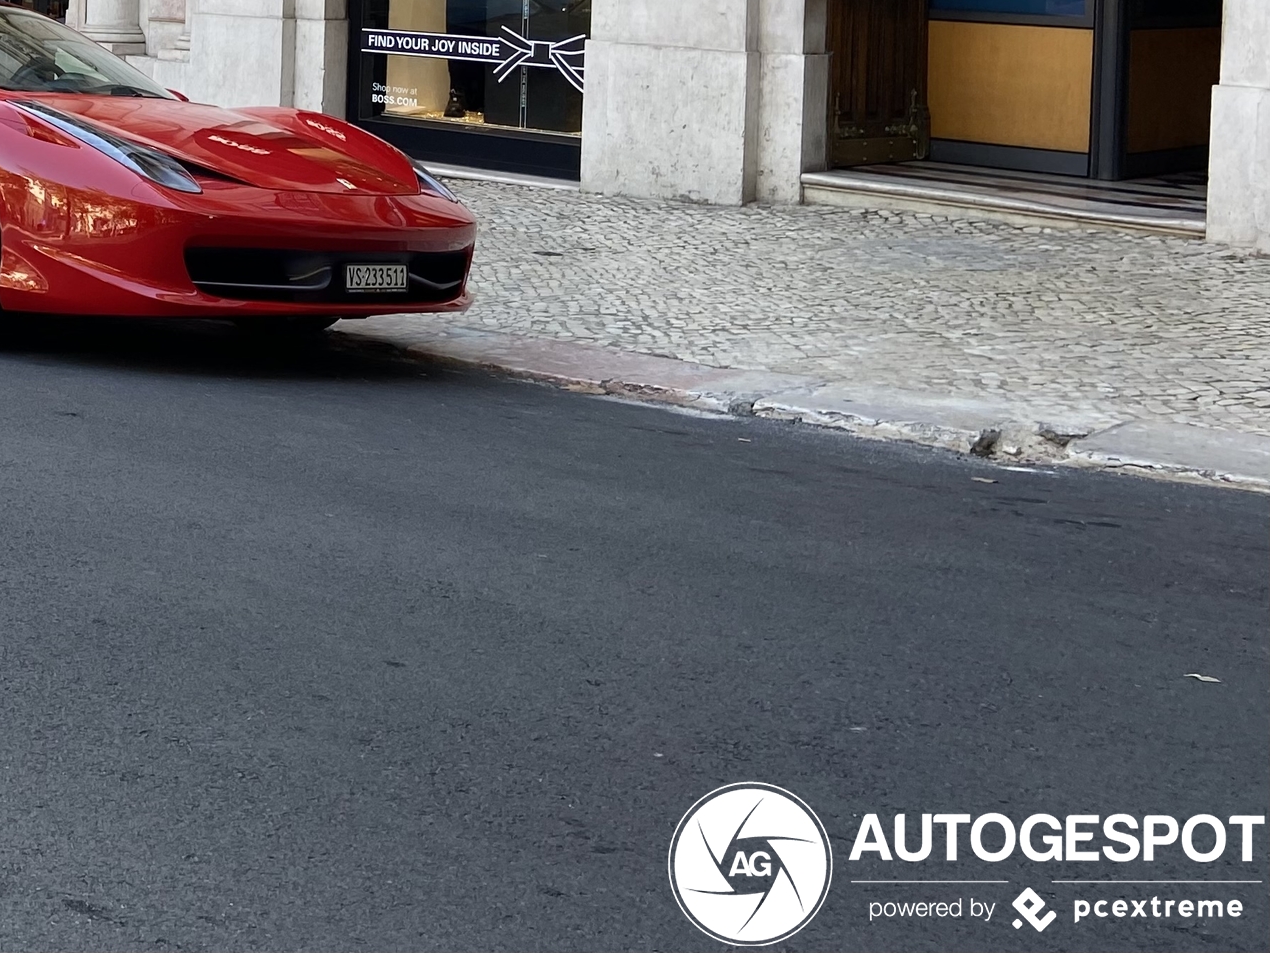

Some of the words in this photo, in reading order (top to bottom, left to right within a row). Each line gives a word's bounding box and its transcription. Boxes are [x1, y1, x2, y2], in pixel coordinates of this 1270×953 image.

[368, 34, 395, 47] FIND
[396, 36, 430, 51] YOUR
[431, 39, 454, 54] JOY
[458, 41, 500, 56] INSIDE
[372, 82, 391, 94] Shop
[392, 85, 408, 94] now
[409, 86, 417, 95] at
[372, 93, 418, 107] BOSS.COM
